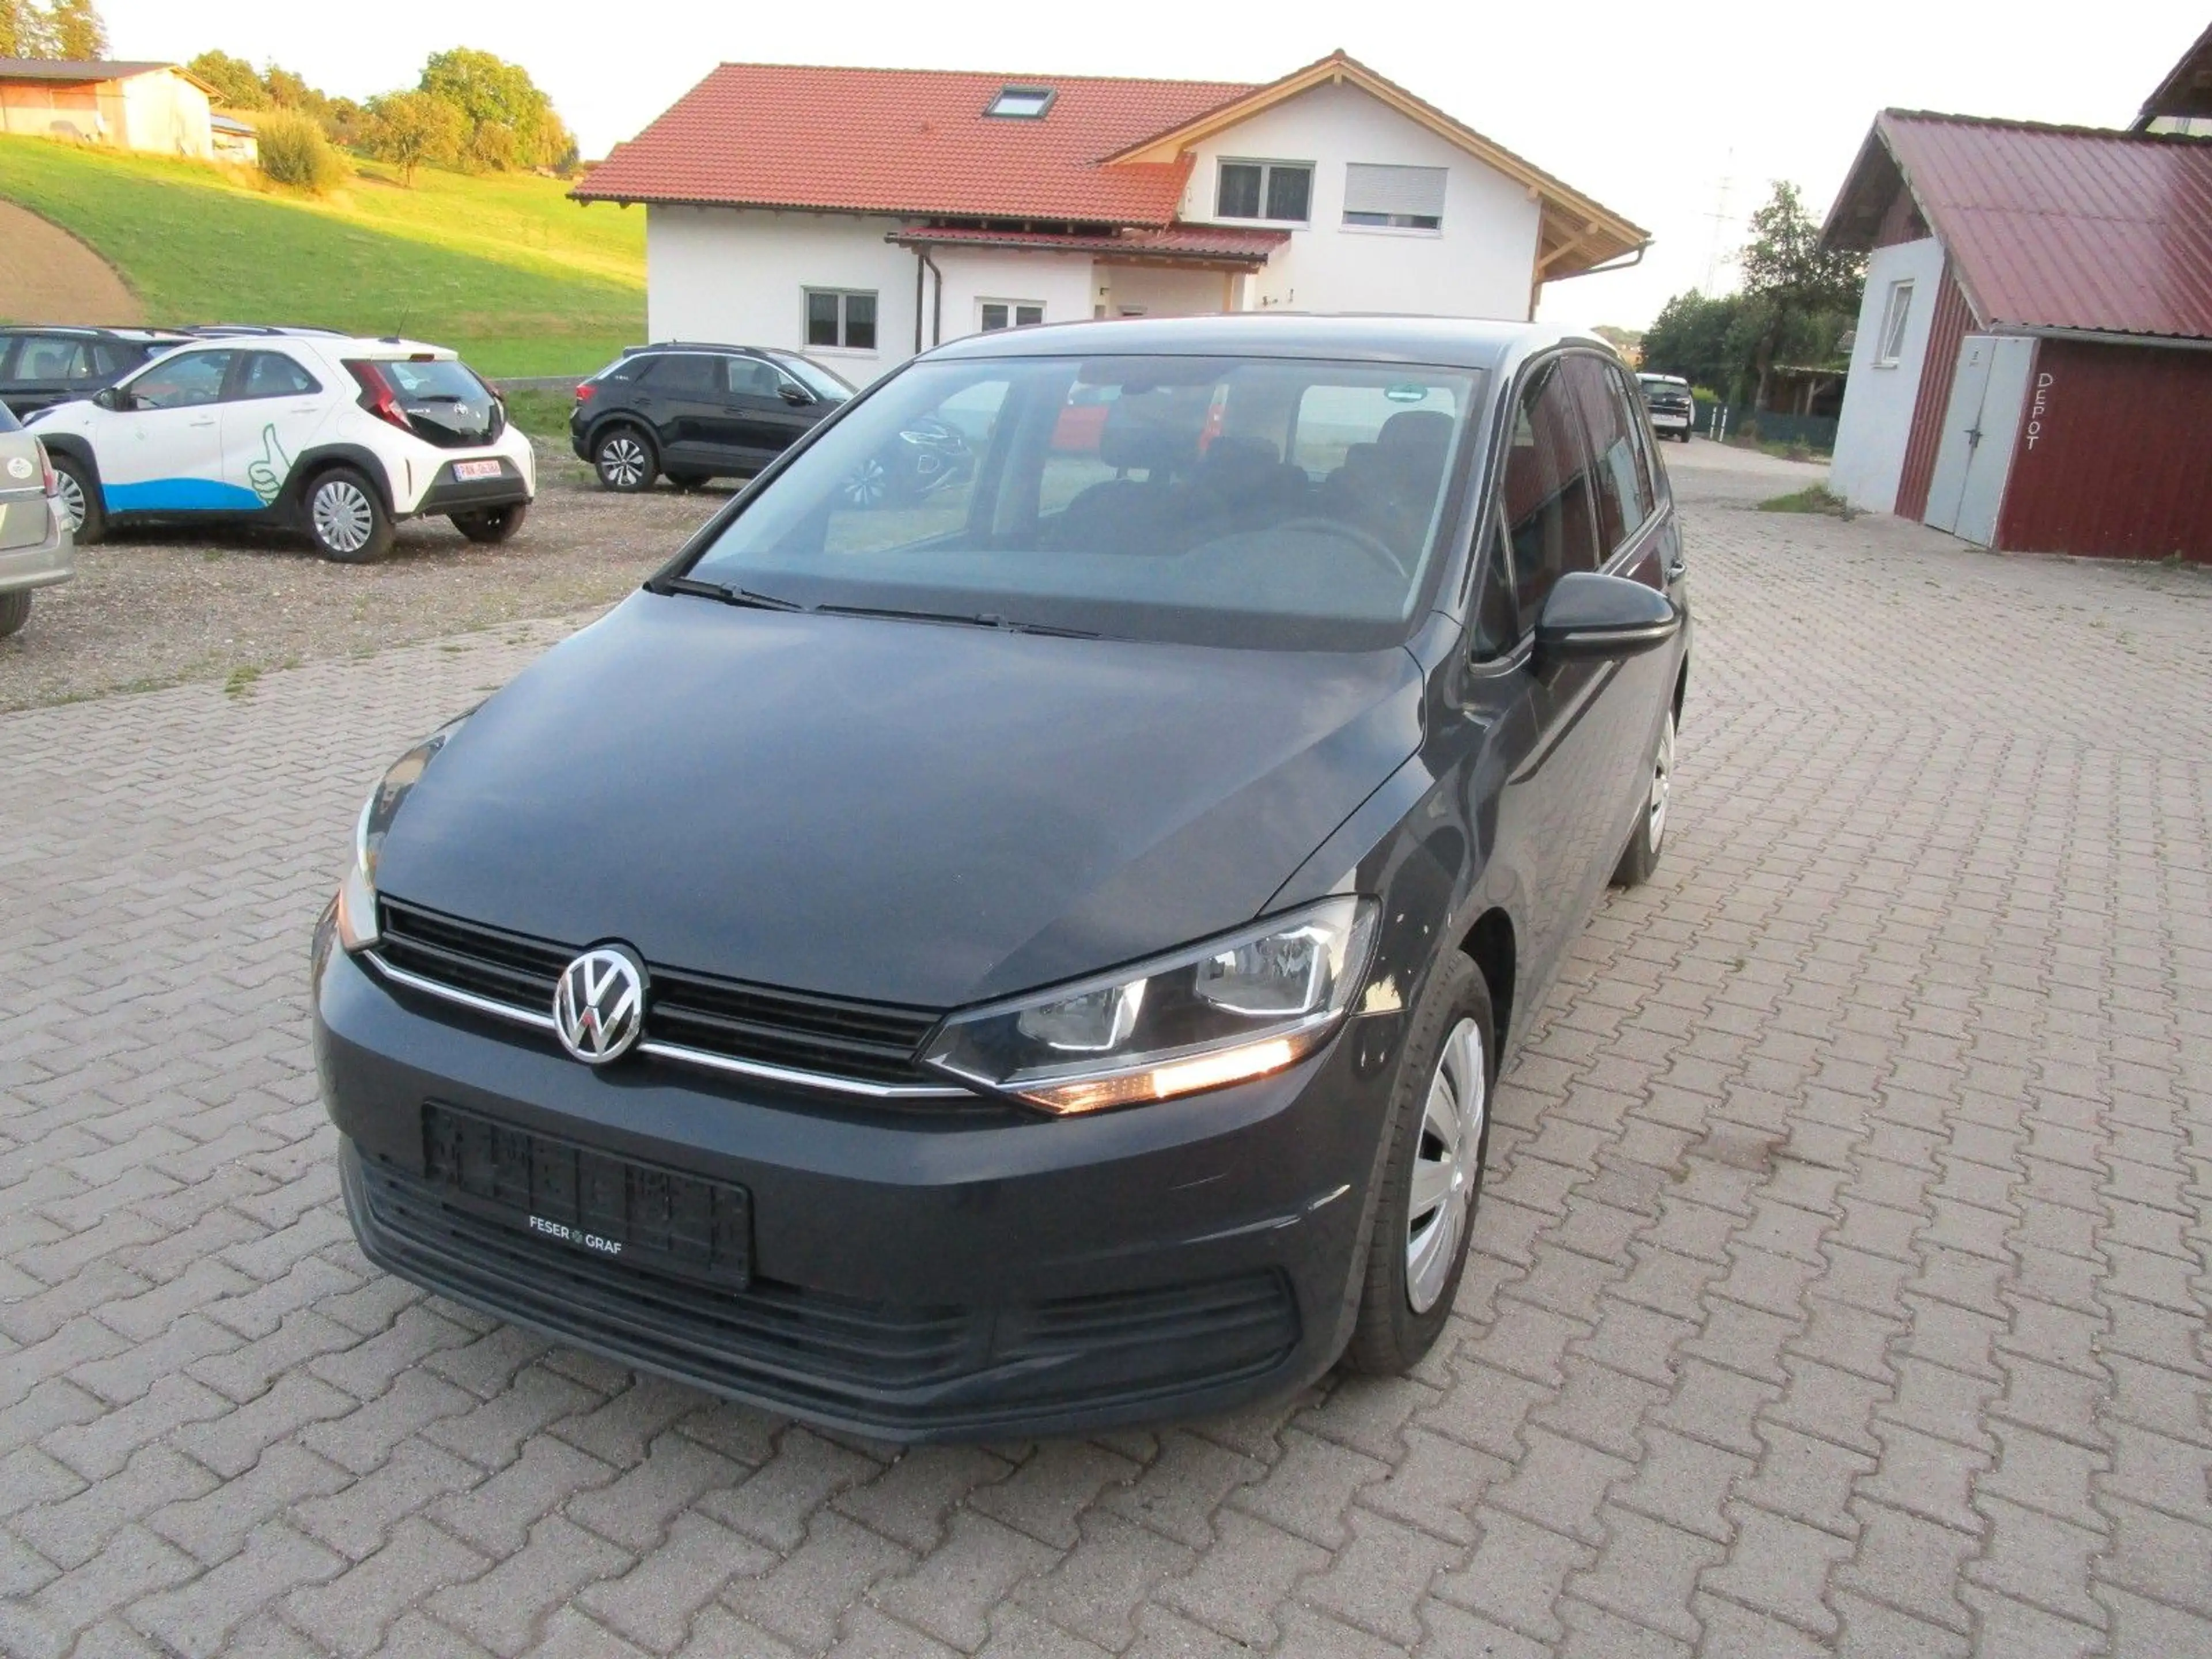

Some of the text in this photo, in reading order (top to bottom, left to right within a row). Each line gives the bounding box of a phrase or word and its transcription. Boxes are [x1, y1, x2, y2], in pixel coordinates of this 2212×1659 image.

[2027, 373, 2053, 450] DEPOT
[529, 1215, 622, 1254] FESER GRAF
